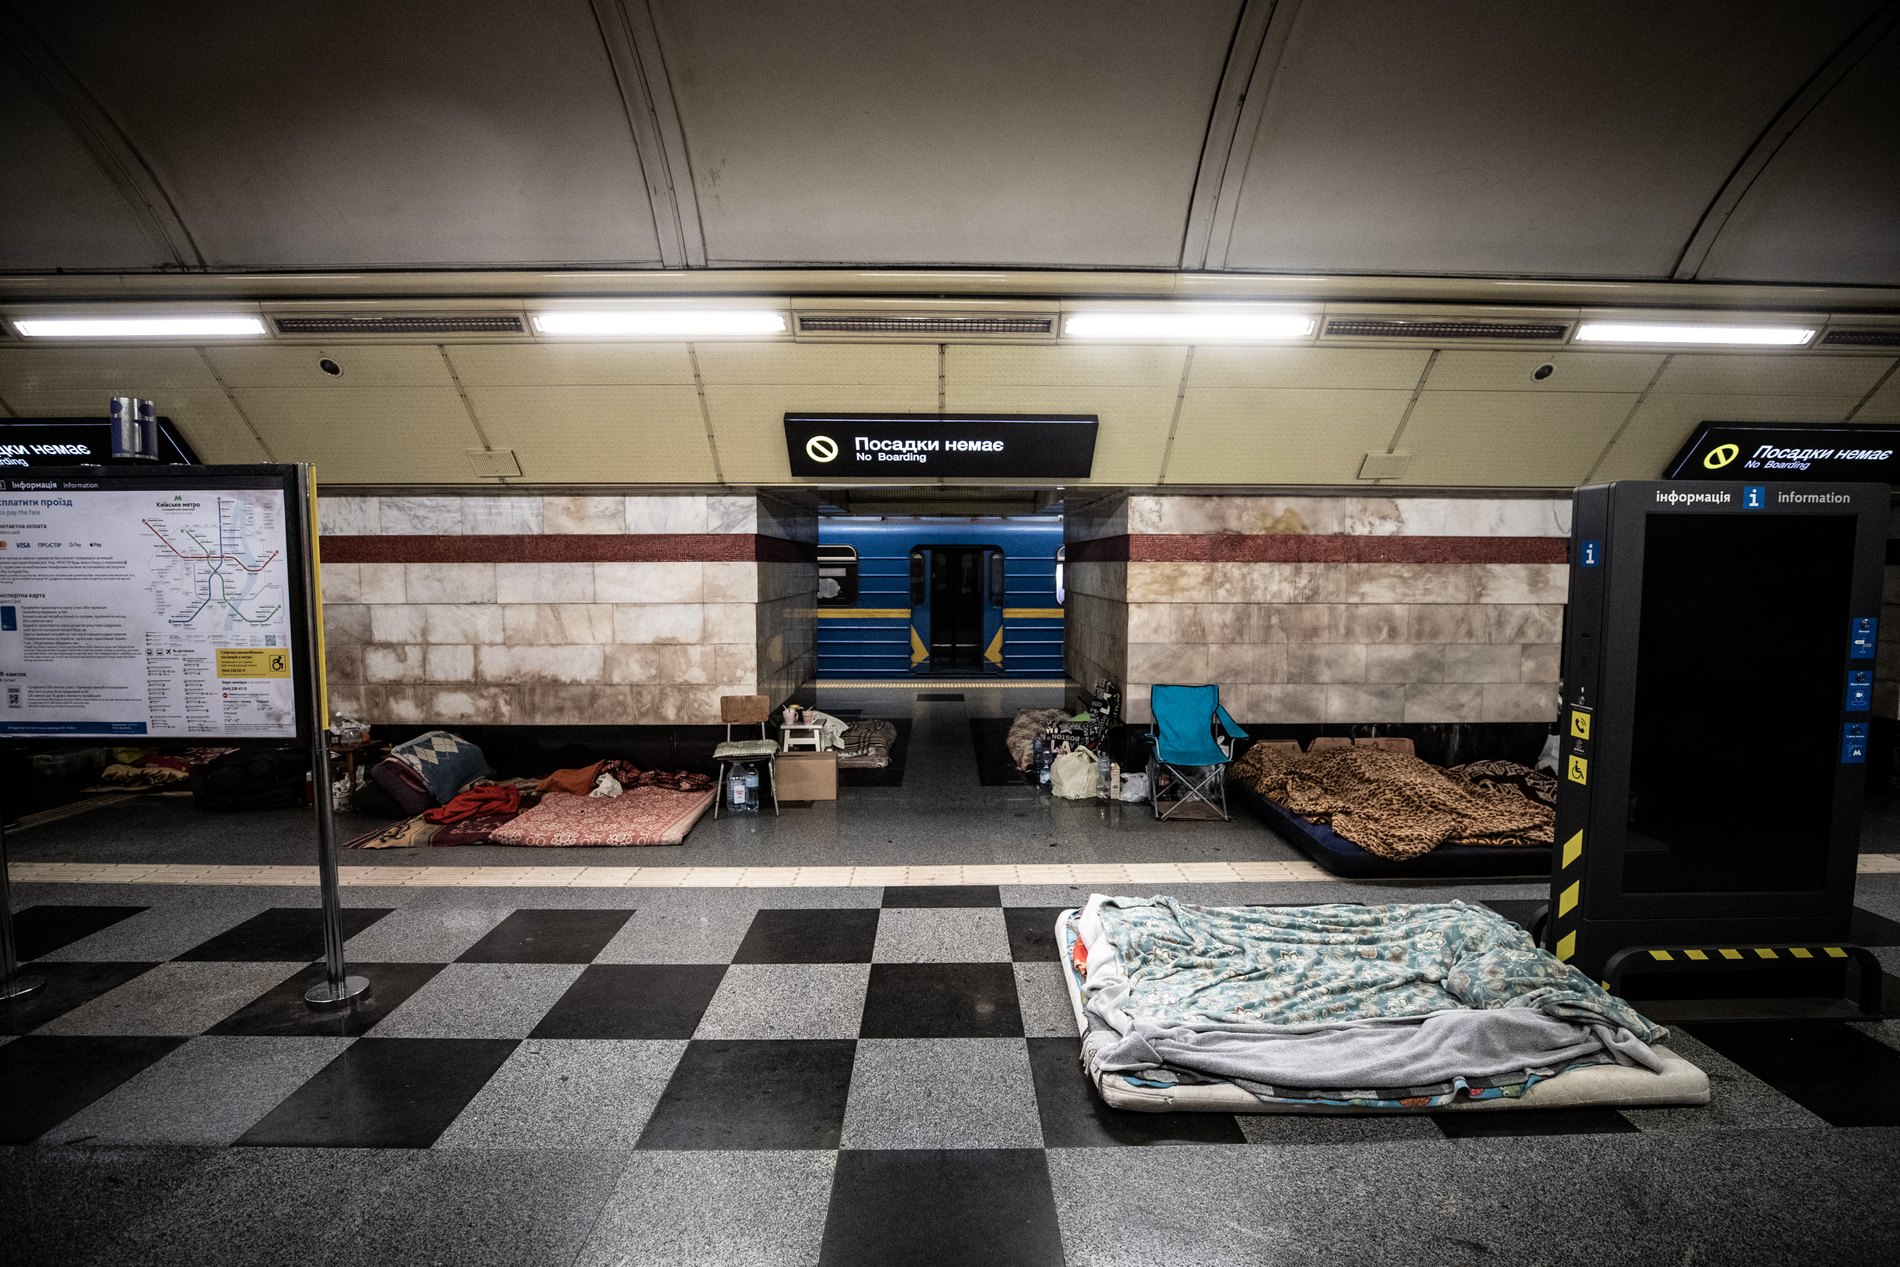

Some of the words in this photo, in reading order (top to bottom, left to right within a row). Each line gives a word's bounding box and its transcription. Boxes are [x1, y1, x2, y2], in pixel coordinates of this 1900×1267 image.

[29, 444, 91, 455] немає
[855, 437, 939, 453] Посадки
[945, 439, 1004, 452] немає
[857, 453, 872, 461] No
[878, 453, 927, 463] Boarding
[1752, 445, 1831, 461] Посадки
[1834, 450, 1894, 461] немає
[1744, 460, 1760, 469] No
[1764, 460, 1811, 471] Boarding
[12, 481, 58, 490] Інформація
[41, 498, 73, 508] проїзд
[1656, 490, 1731, 506] інформація
[1778, 491, 1851, 504] information
